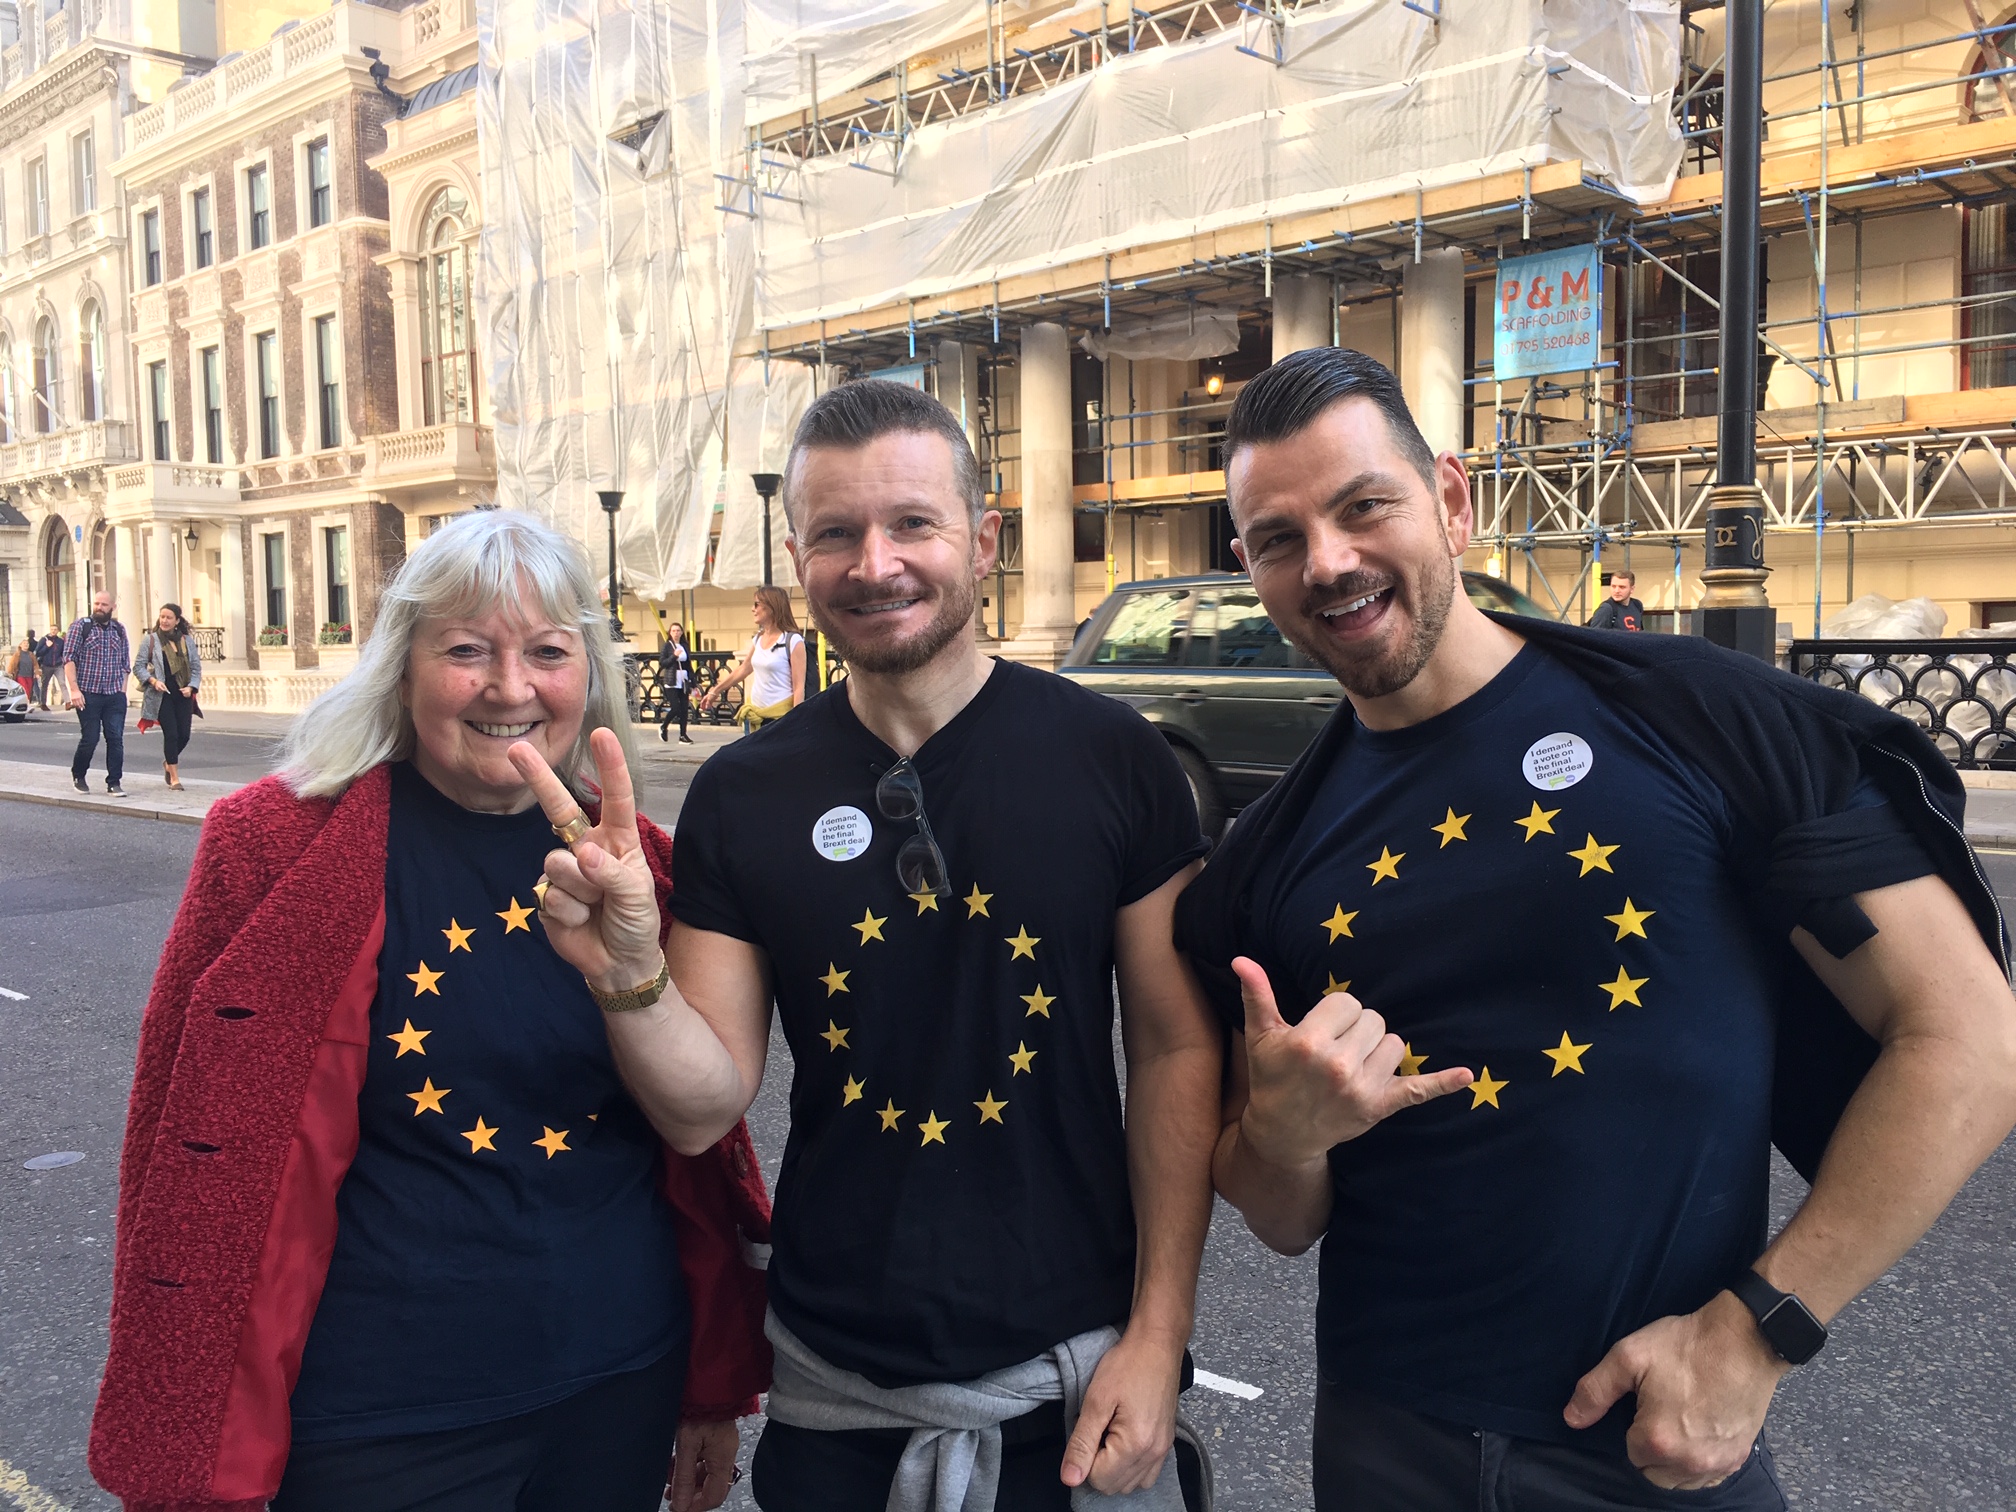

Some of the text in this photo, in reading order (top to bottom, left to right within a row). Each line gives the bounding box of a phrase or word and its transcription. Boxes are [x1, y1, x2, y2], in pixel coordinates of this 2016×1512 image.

[1501, 267, 1590, 315] P & M
[1501, 306, 1592, 332] SCAFFOLDING
[1500, 331, 1591, 356] 01795 520468
[1535, 740, 1573, 756] demand
[1540, 752, 1560, 763] vote
[1561, 749, 1574, 757] on
[1534, 757, 1572, 773] the final
[1536, 767, 1564, 780] Brexit
[1564, 761, 1585, 772] deal
[825, 814, 857, 825] demand
[828, 824, 845, 832] vote
[836, 830, 854, 839] final
[823, 837, 865, 849] Brexit deal
